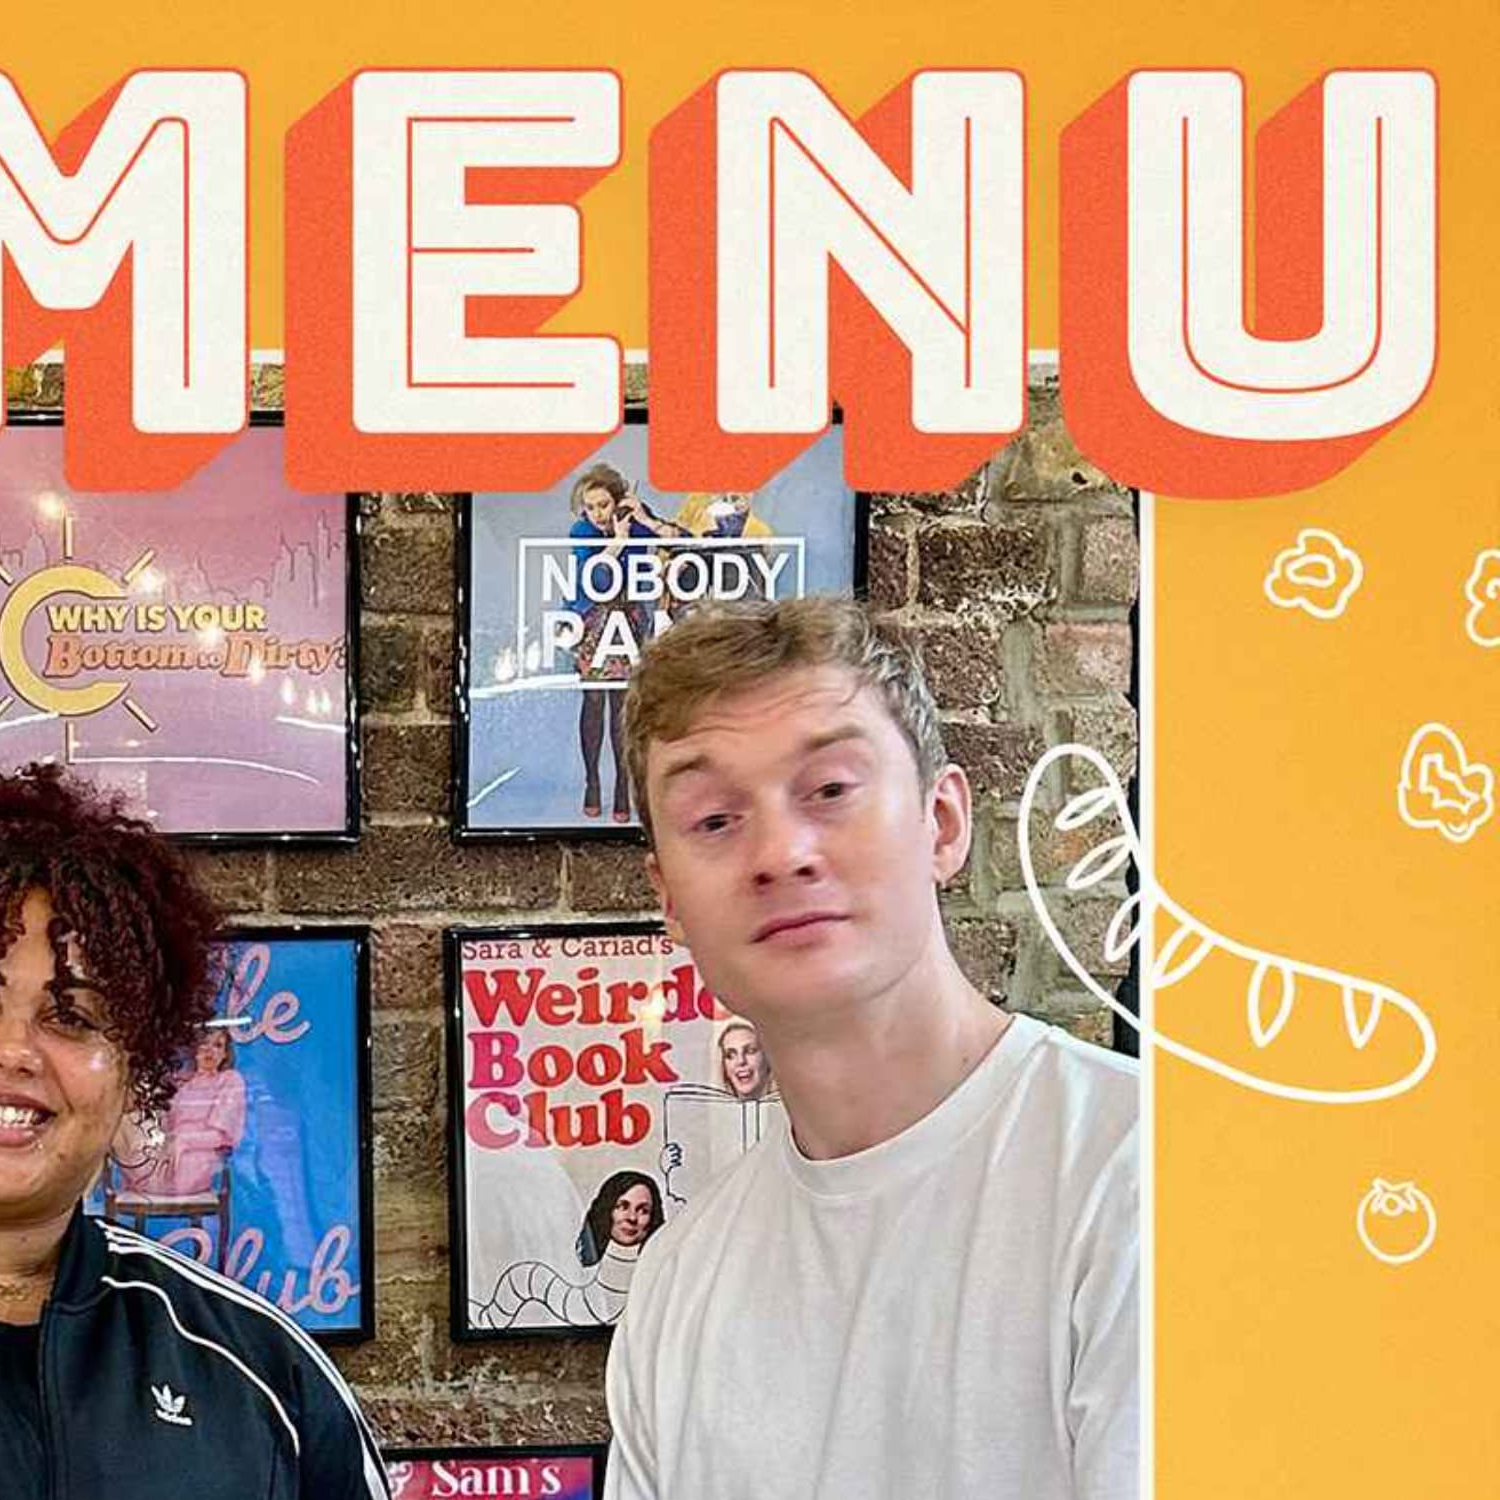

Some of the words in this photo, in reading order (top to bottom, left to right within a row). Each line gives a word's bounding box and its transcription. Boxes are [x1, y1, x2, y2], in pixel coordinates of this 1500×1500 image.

[542, 552, 791, 602] NOBODY
[46, 604, 130, 632] WHY
[135, 604, 167, 632] IS
[169, 602, 269, 633] YOUR
[542, 608, 673, 669] PA
[42, 634, 197, 679] Bottom
[462, 940, 524, 960] Sara
[532, 939, 552, 958] &
[560, 936, 673, 957] Cariad's
[467, 1028, 680, 1089] Book
[465, 1089, 652, 1149] Club
